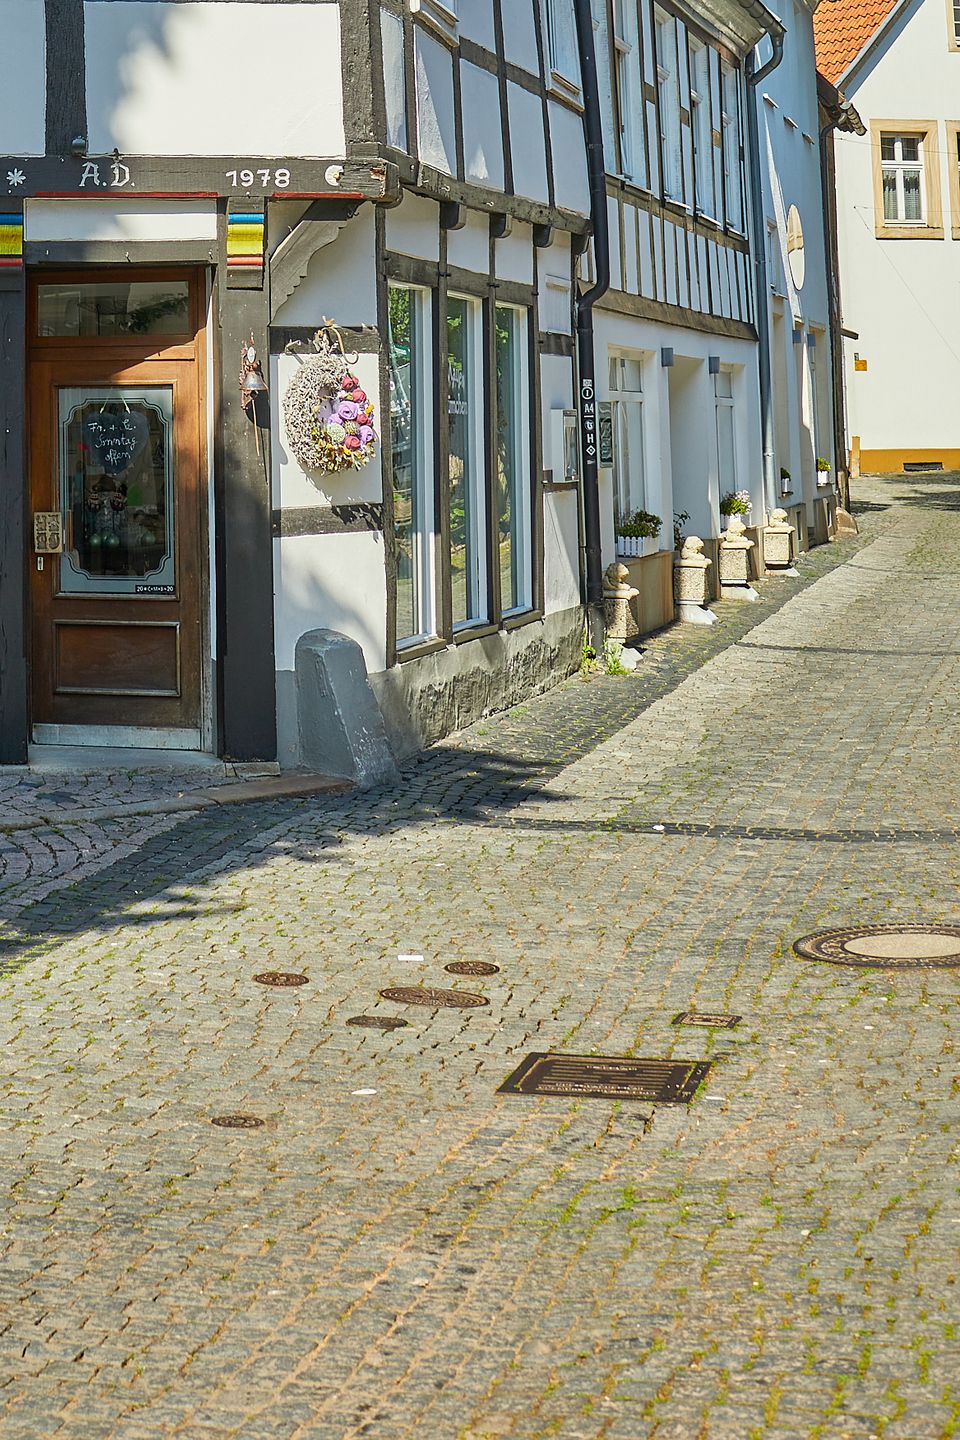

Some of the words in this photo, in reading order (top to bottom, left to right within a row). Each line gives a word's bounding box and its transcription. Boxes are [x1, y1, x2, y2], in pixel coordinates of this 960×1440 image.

[78, 161, 136, 187] A.D.
[225, 168, 291, 188] 1978
[584, 403, 594, 413] A4
[95, 433, 138, 451] Sonntag
[586, 433, 594, 444] H
